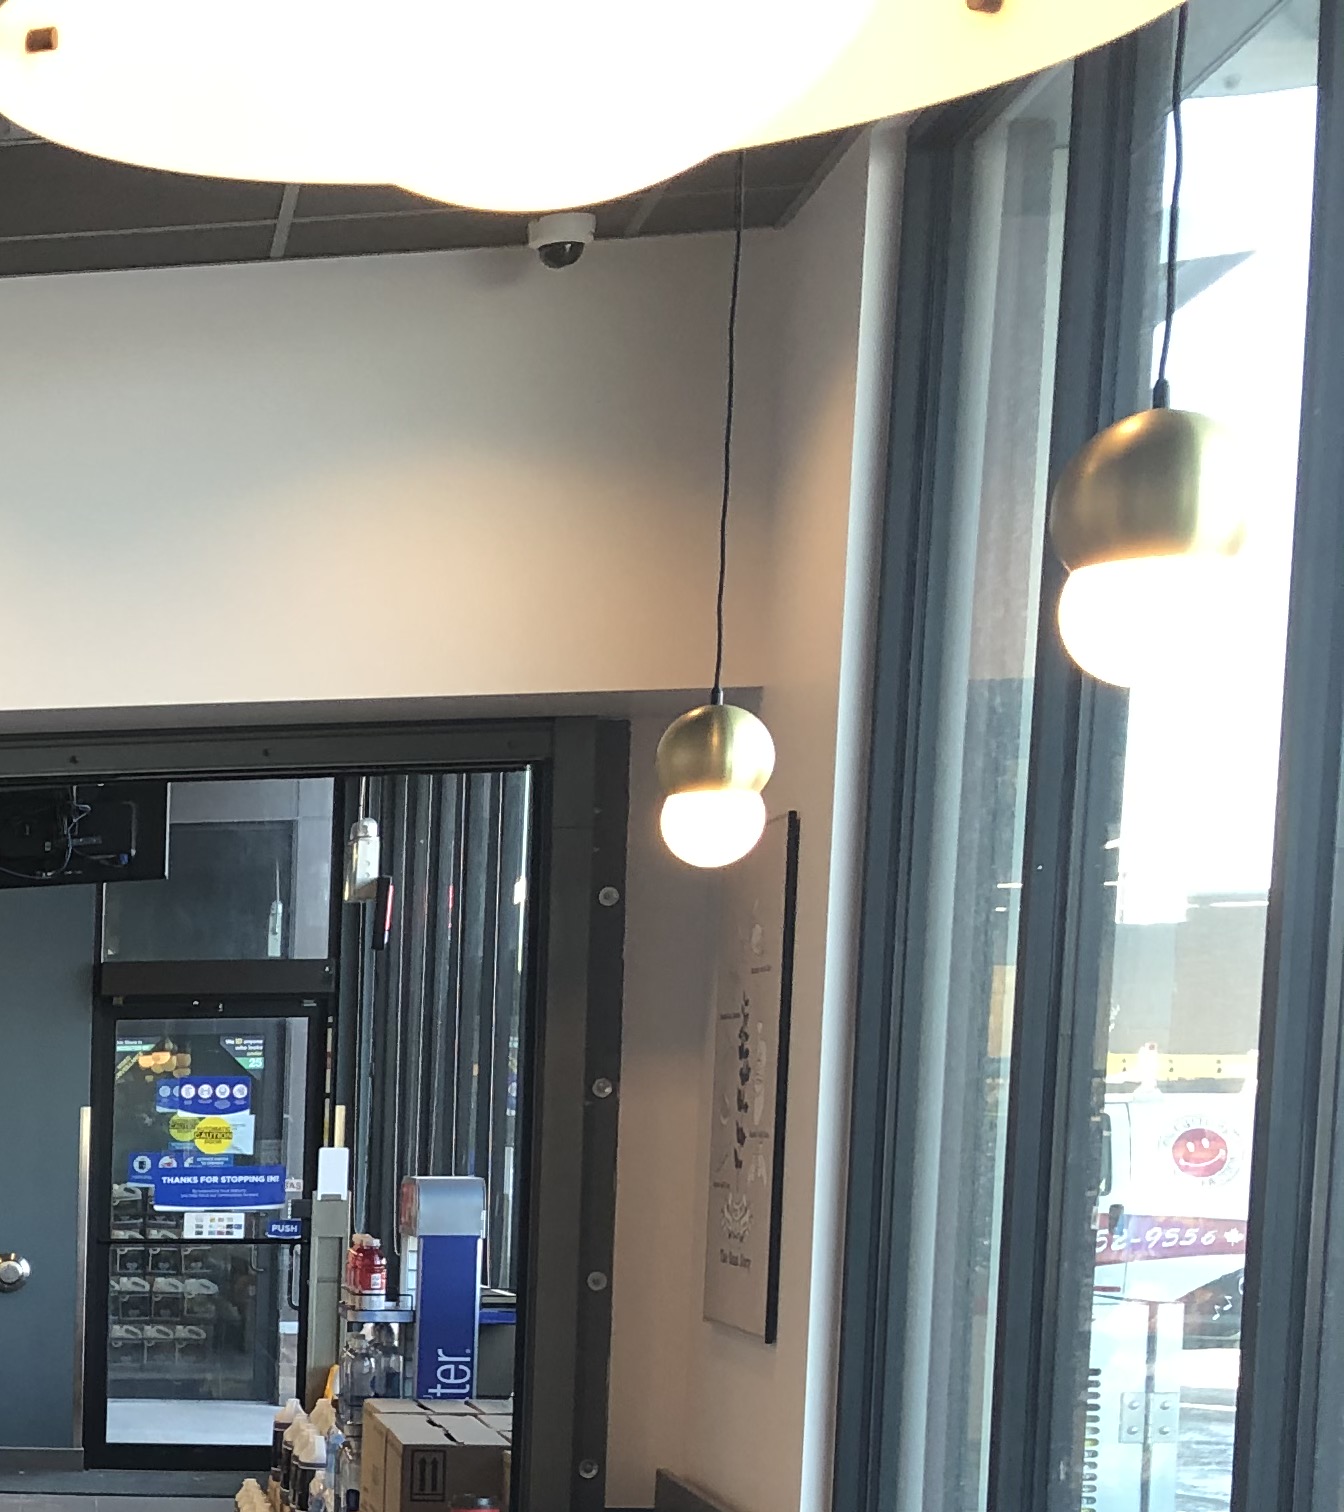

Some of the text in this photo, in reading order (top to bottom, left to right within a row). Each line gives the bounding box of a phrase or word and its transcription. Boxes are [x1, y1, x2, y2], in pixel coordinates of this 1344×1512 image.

[248, 1058, 263, 1067] 25
[194, 1131, 233, 1140] CAUTION
[162, 1176, 199, 1184] THANKS
[220, 1175, 265, 1183] STOPPING
[272, 1224, 298, 1233] PUSH
[428, 1348, 471, 1398] ter.
